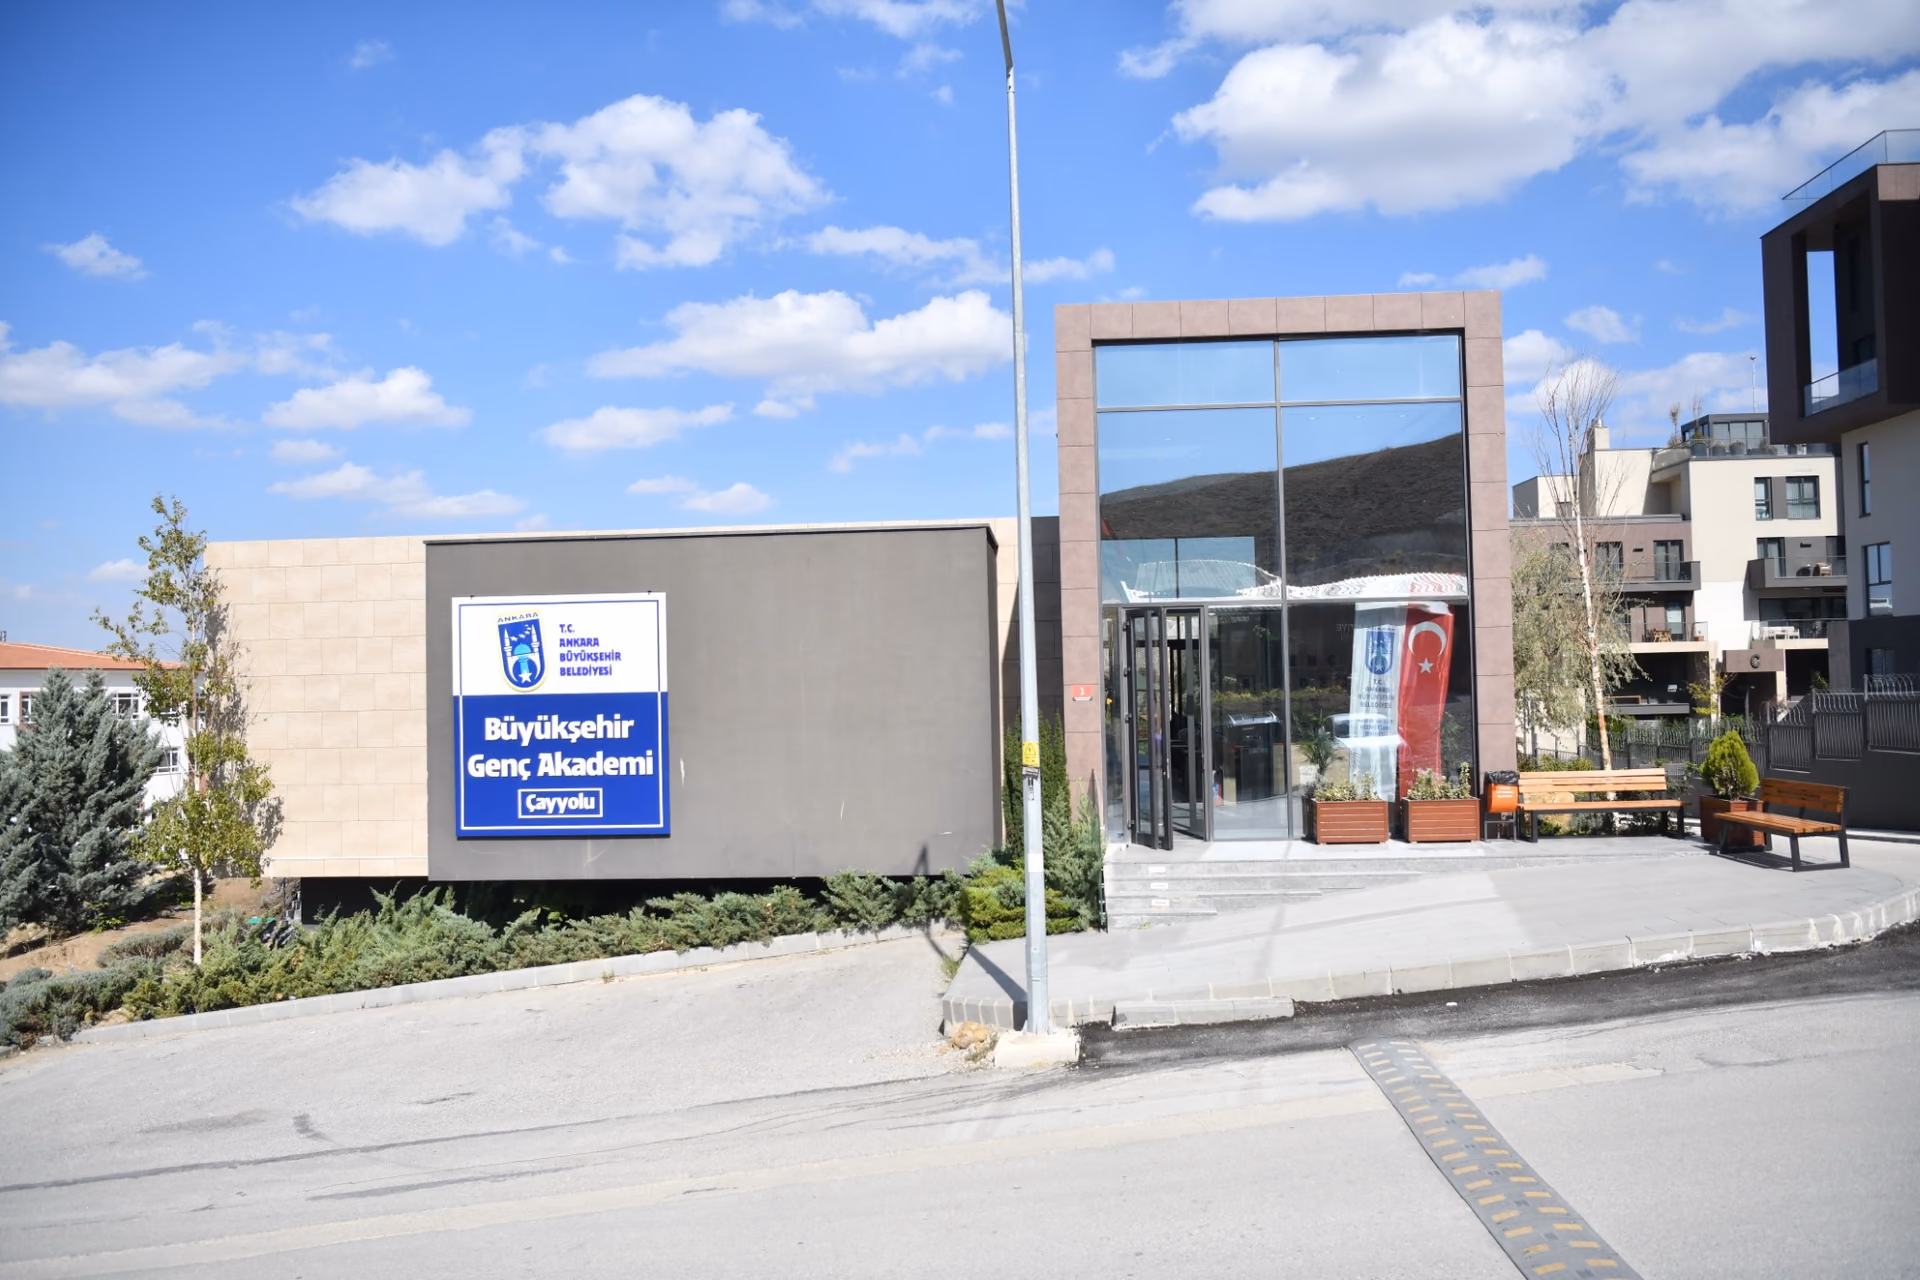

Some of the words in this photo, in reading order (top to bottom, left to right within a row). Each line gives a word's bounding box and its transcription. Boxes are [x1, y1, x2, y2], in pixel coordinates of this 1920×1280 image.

[498, 612, 539, 623] ANKARA
[559, 623, 575, 633] T.C.
[559, 637, 599, 648] ANKARA
[559, 649, 622, 663] BÜYÜKŞEHİR
[559, 663, 612, 676] BELEDİYESİ
[484, 713, 635, 747] Büyükşehir
[467, 753, 532, 781] Genç
[537, 749, 654, 777] Akademi
[525, 792, 596, 814] Çayyolu
